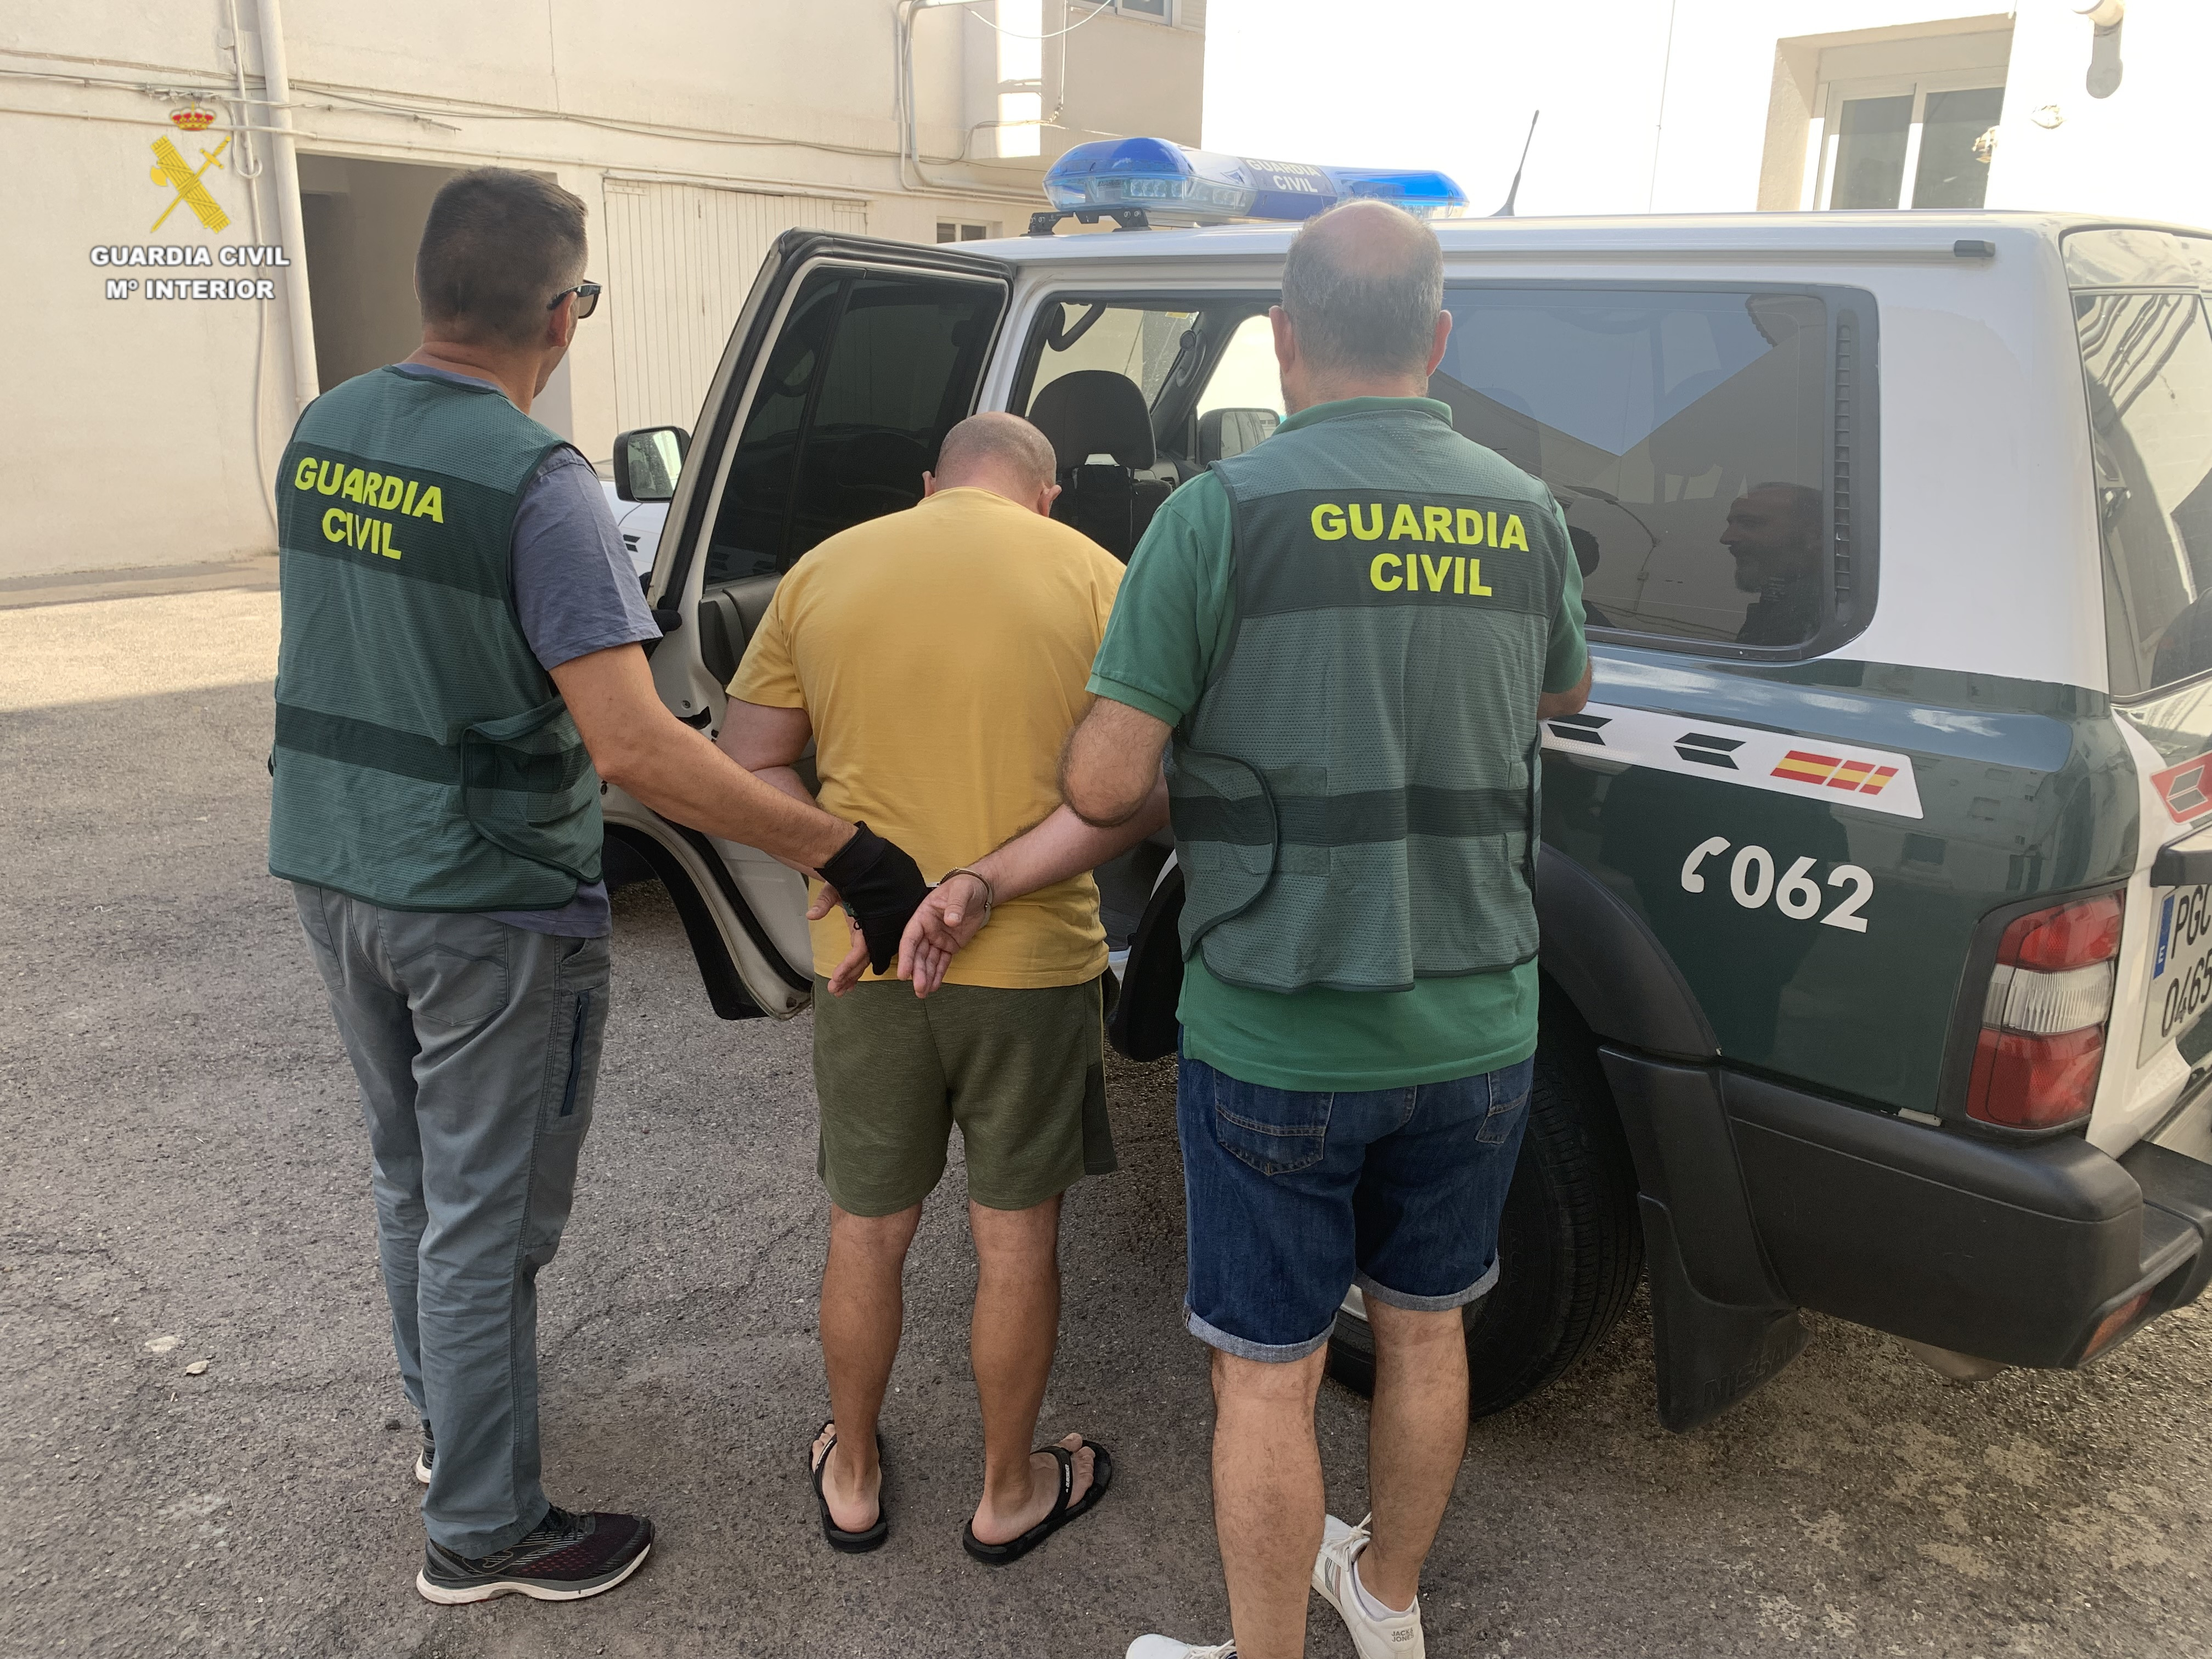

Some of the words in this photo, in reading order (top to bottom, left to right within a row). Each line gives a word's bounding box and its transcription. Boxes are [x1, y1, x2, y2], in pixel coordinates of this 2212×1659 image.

[1246, 159, 1321, 177] GUARDIA
[1273, 175, 1318, 193] CIVIL
[295, 457, 443, 523] GUARDIA
[322, 508, 402, 560] CIVIL
[1311, 503, 1529, 552] GUARDIA
[1370, 553, 1492, 596] CIVIL
[1730, 845, 1874, 933] 062
[2171, 884, 2211, 959] PGC
